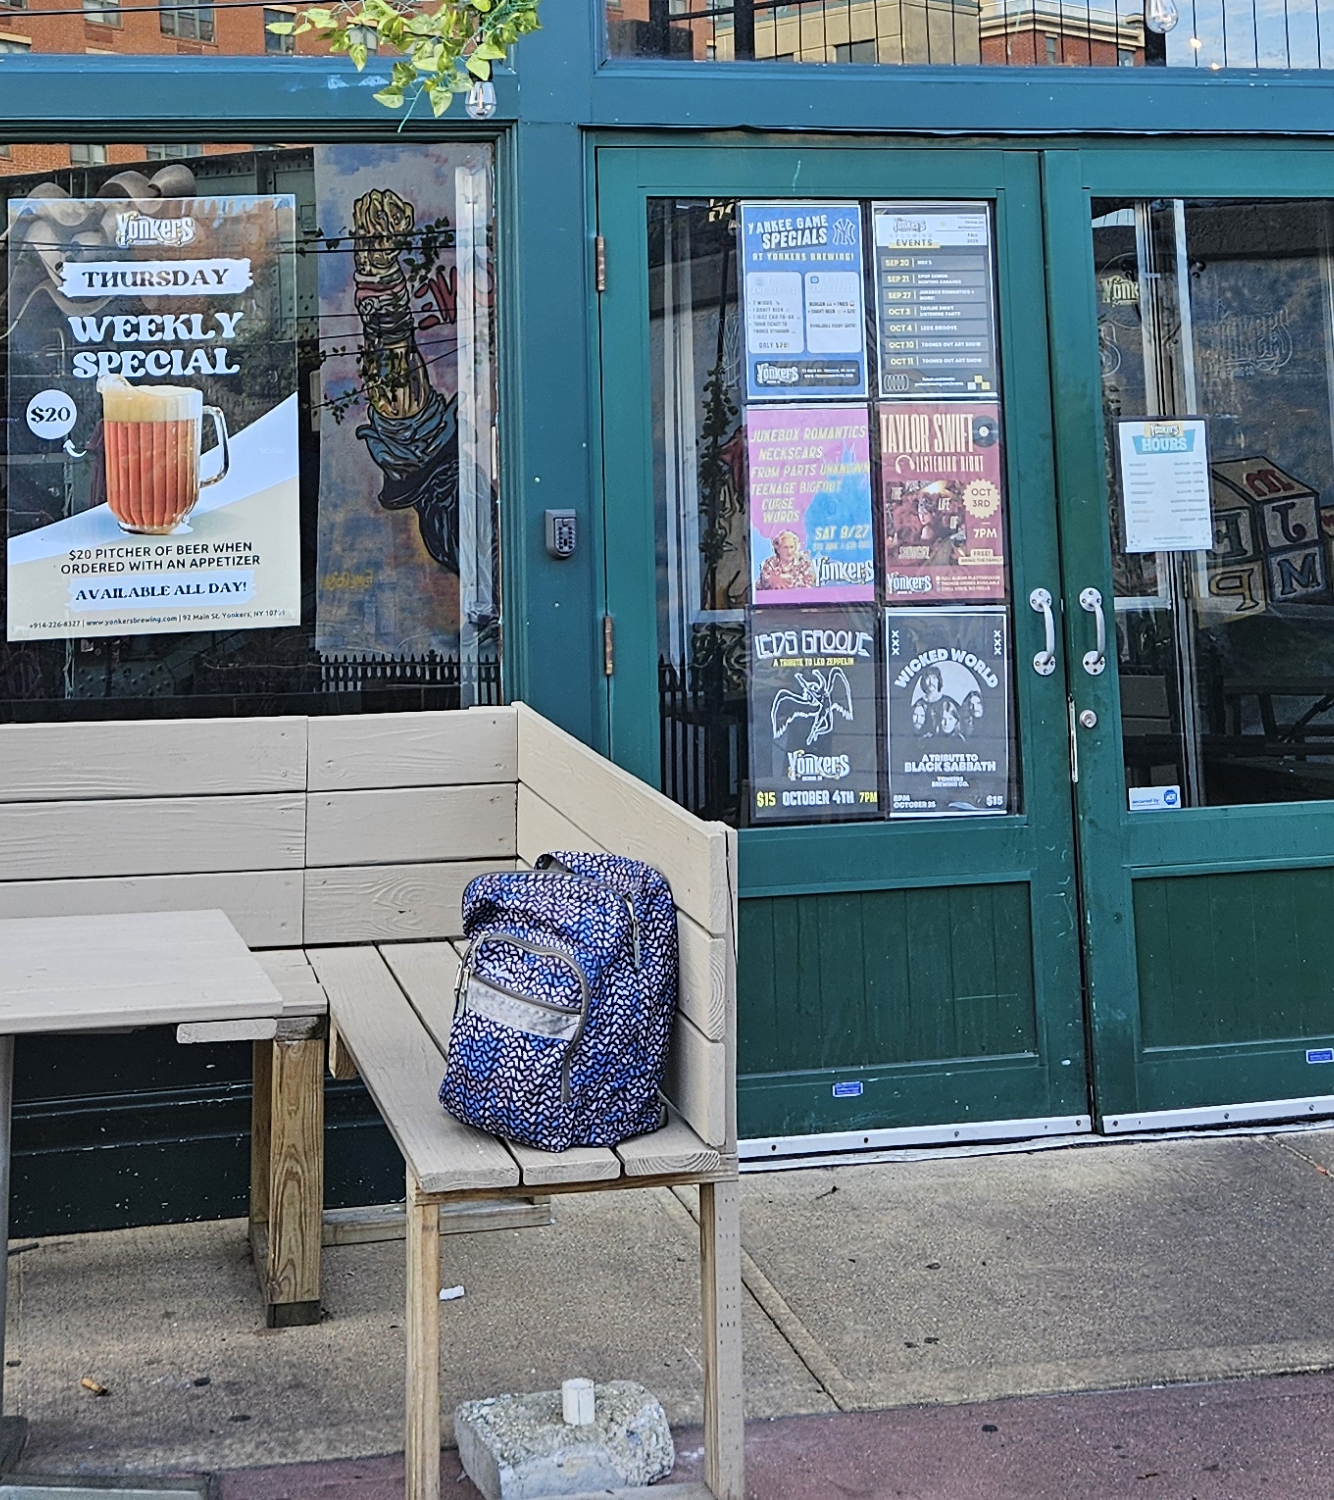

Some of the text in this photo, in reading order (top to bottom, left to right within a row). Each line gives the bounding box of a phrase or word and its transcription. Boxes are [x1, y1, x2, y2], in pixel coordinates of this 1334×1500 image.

[116, 211, 196, 248] Yonkers
[748, 214, 828, 235] YANKEE GAME
[762, 227, 828, 250] SPECIALS
[766, 253, 806, 261] YONKERS
[810, 252, 855, 261] BREWING!
[82, 268, 230, 288] THURSDAY
[887, 275, 910, 283] SEP 21
[68, 311, 244, 343] WEEKLY
[72, 348, 240, 379] SPECIAL
[756, 363, 799, 384] Yonkers
[30, 406, 71, 425] $20
[750, 425, 867, 443] JUKEBOX ROMANTICS
[880, 413, 974, 453] TAYLOR SWIFT
[1141, 437, 1188, 451] HOURS
[759, 445, 825, 461] NECKSCARS
[751, 461, 870, 478] FROM PARTS UNKNOWN
[916, 455, 984, 472] LISTENING NIGHT
[750, 480, 842, 496] TEENAGE BIGFOOT
[971, 488, 991, 496] OCT
[762, 497, 795, 510] CURSE
[972, 500, 991, 508] 3RD
[763, 510, 800, 523] WORDS
[815, 524, 870, 540] SAT 9/27
[973, 528, 998, 538] 7PM
[69, 542, 253, 562] $20 PITCHER OF BEER WHEN
[61, 555, 261, 575] ORDERED WITH AN APPETIZER
[812, 556, 874, 587] Yonkers
[75, 581, 247, 601] AVAILABLE ALL DAY!
[887, 572, 933, 594] Yonkers
[193, 613, 210, 621] Main
[253, 610, 264, 618] NY
[773, 657, 855, 667] A TRIBUTE TO LED ZEPPELIN
[894, 648, 999, 688] WICKED WORLD
[787, 749, 851, 781] Yonkers
[921, 753, 979, 762] A TRIBUTE TO
[904, 761, 996, 772] BLACK SABBATH
[756, 789, 878, 807] $15 OCTOBER 4TH 7PM
[986, 794, 1003, 806] $15
